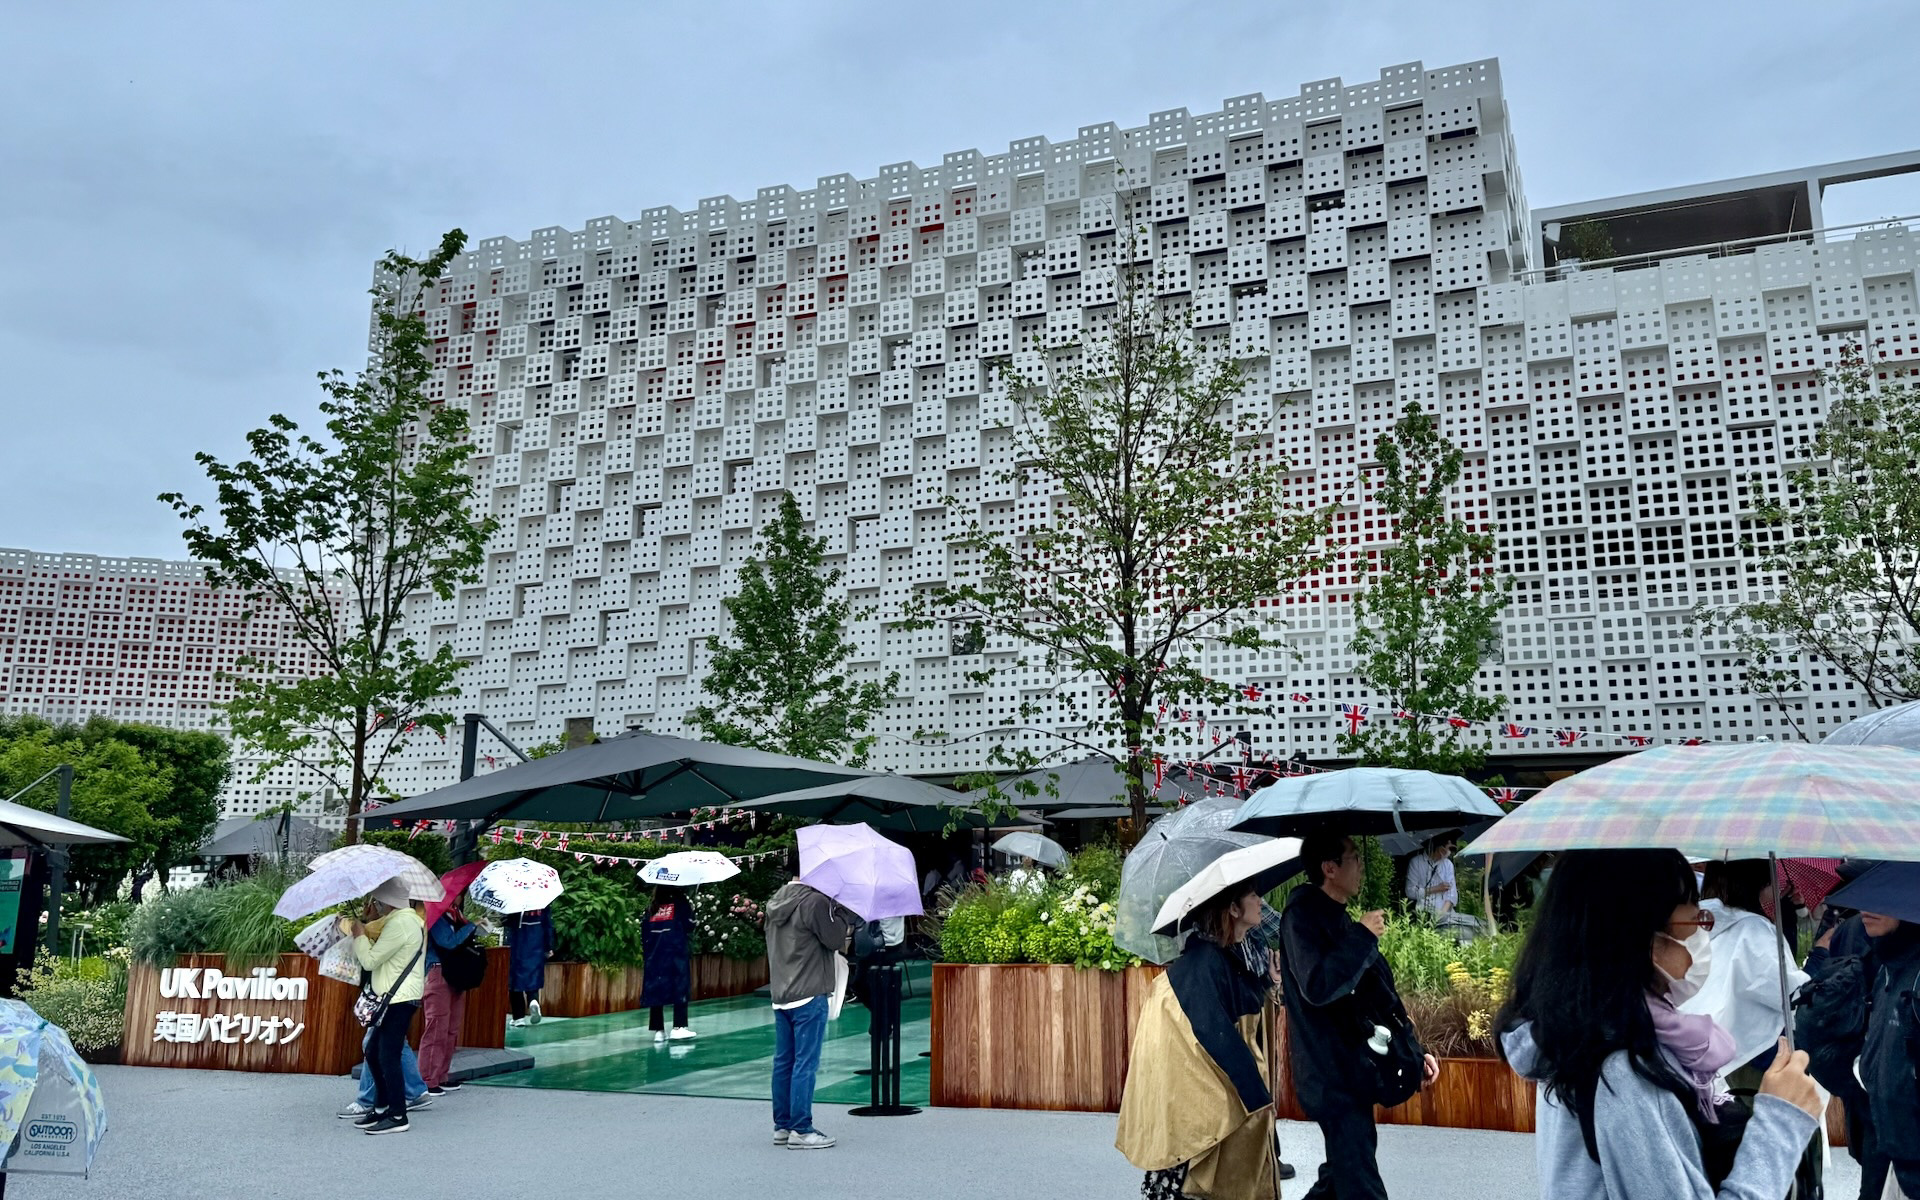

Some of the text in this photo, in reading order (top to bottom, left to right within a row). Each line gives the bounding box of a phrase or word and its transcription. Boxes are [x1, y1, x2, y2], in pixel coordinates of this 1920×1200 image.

[159, 966, 309, 1001] UK Pavilion
[152, 1010, 305, 1046] 英国パビリオン
[29, 1124, 73, 1140] OUTDOOR
[42, 1143, 66, 1151] ANGELES
